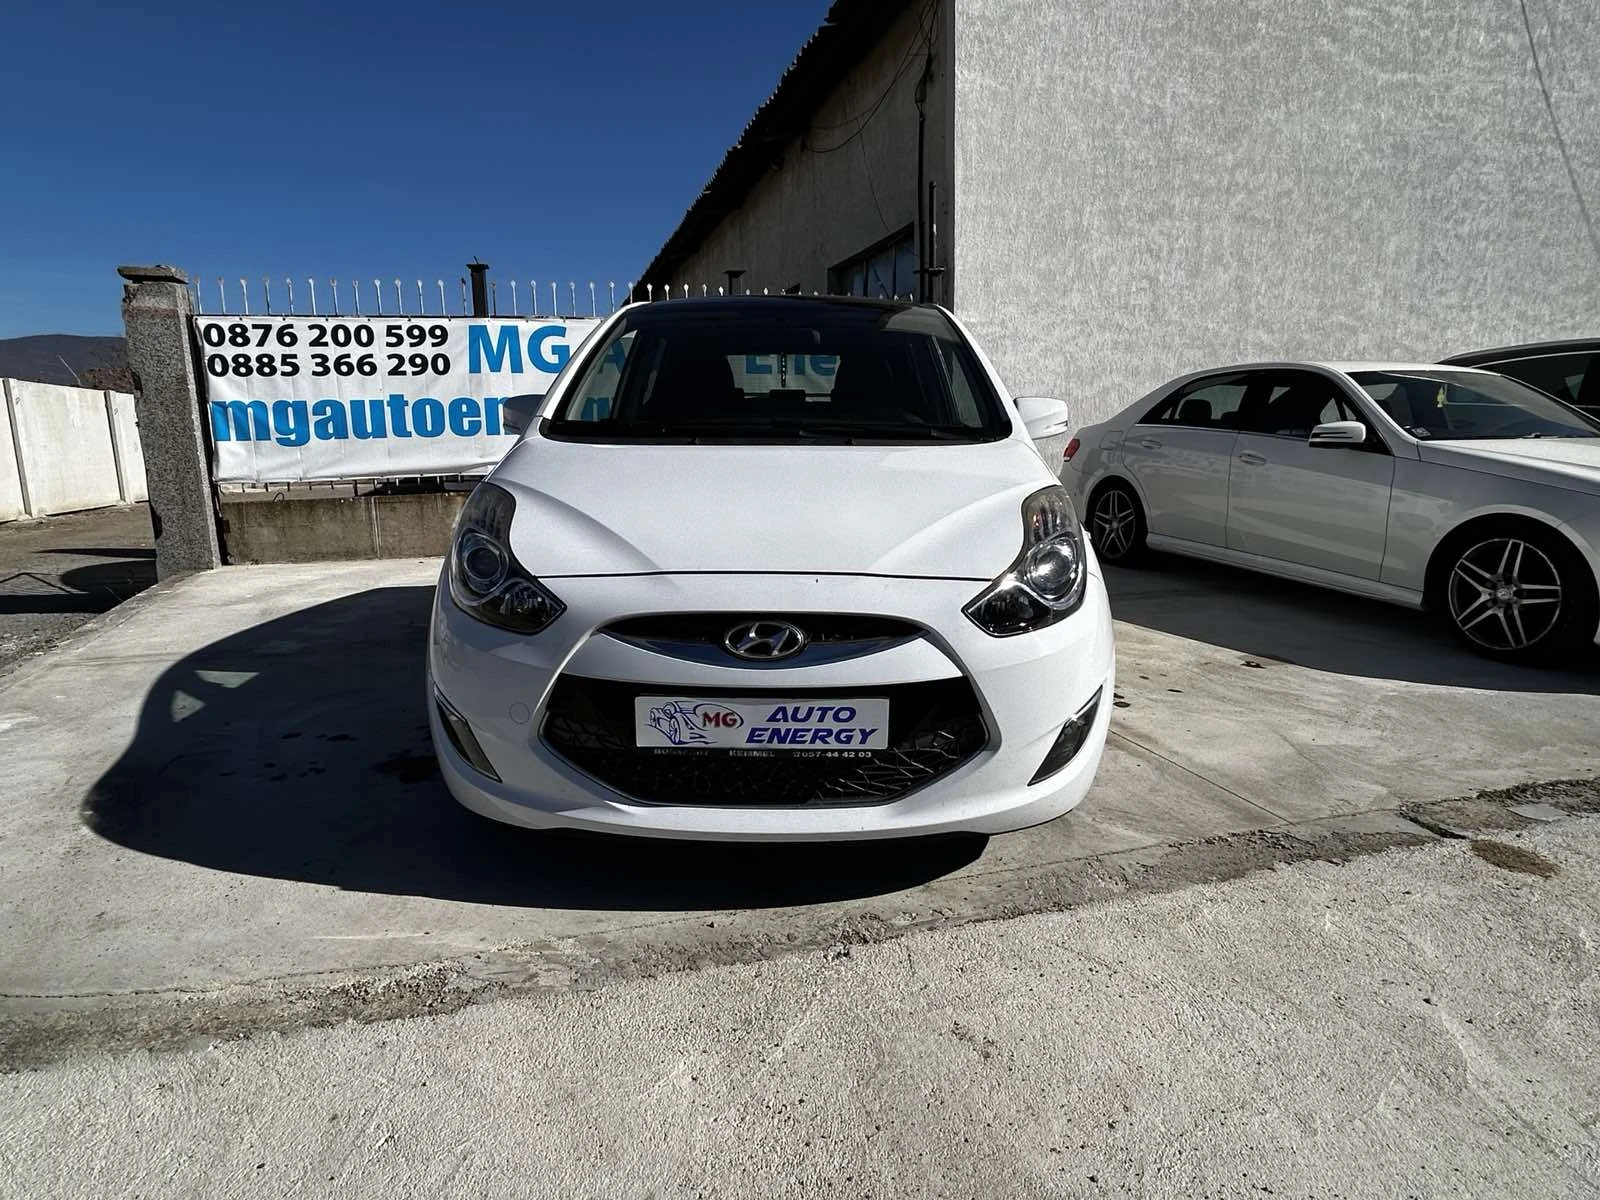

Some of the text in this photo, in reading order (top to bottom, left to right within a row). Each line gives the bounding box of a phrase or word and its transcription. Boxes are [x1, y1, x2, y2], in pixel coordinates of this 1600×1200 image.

[203, 323, 449, 348] 0876 200 599
[468, 324, 571, 375] MG
[207, 353, 450, 378] 0885 366 290
[703, 711, 738, 728] MG
[766, 706, 857, 723] AUTO
[745, 727, 879, 745] ENERGY
